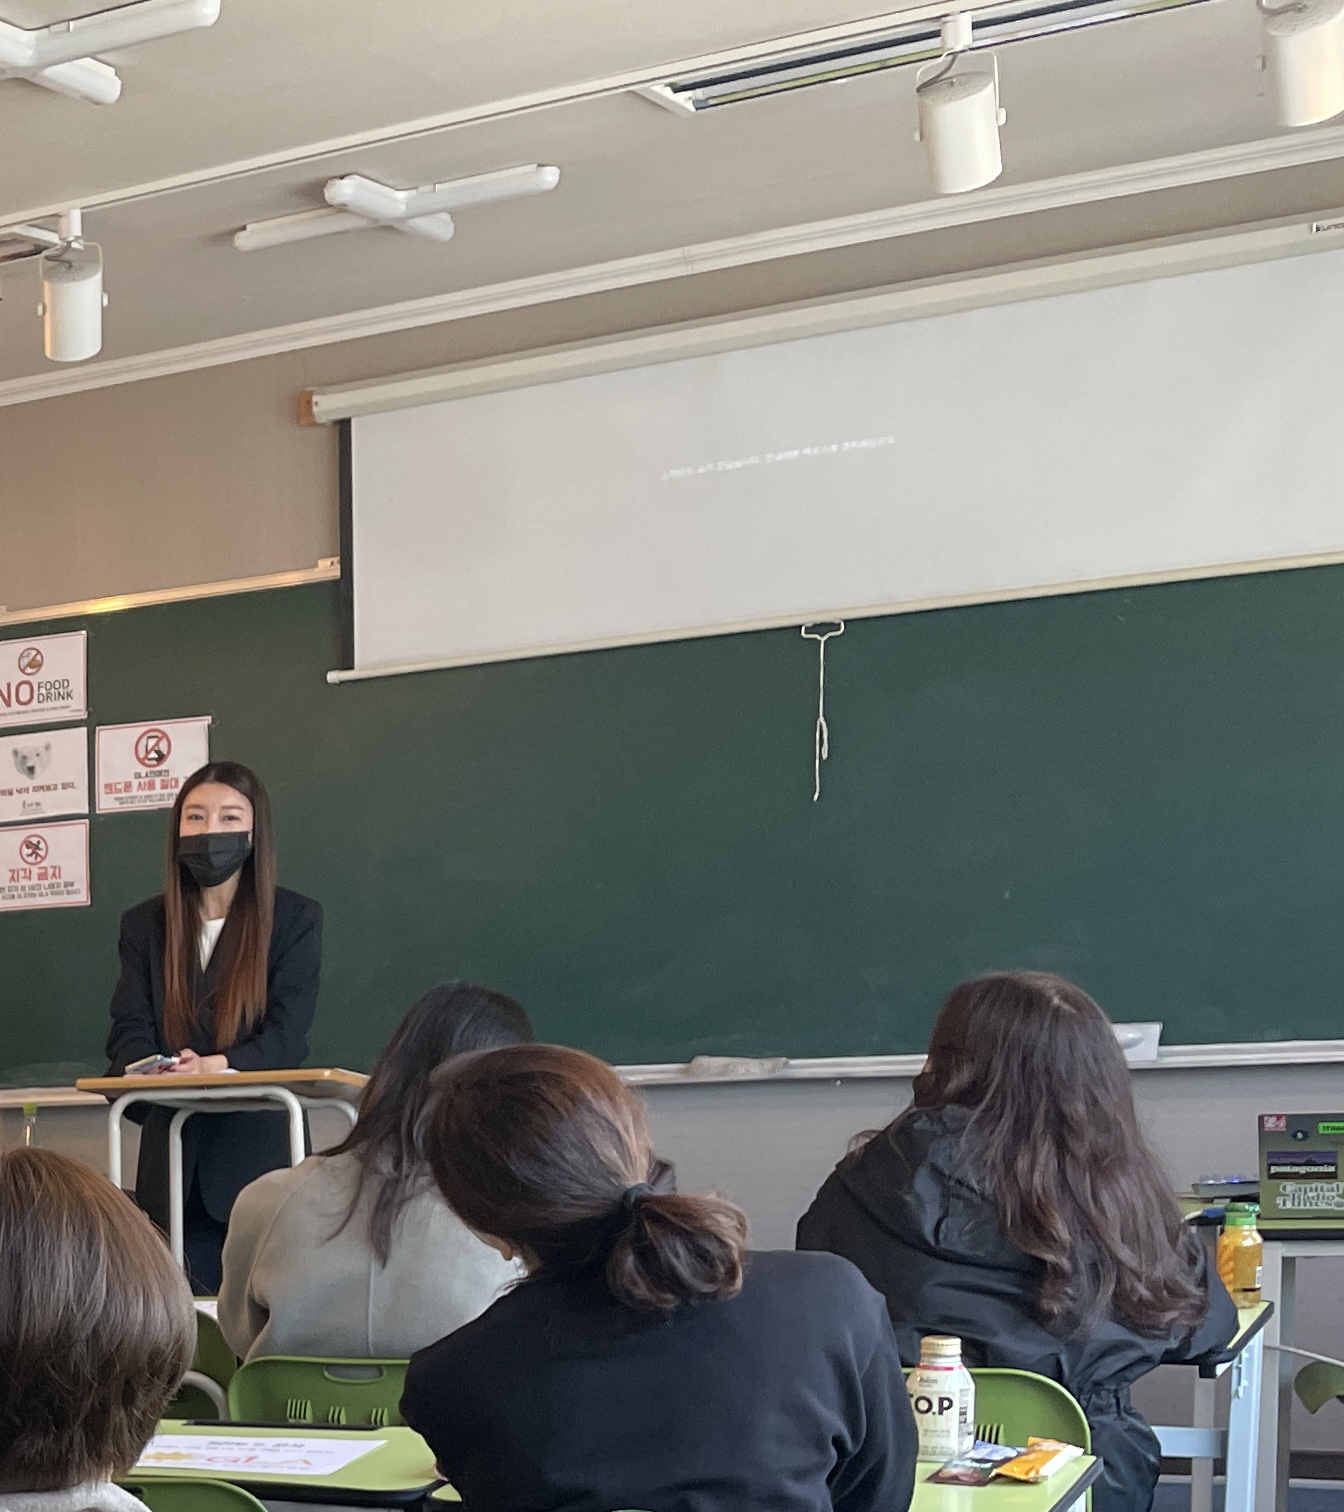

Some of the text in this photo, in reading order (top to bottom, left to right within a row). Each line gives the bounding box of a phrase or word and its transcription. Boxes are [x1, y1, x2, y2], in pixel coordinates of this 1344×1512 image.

[37, 679, 70, 692] FOOD
[37, 690, 74, 704] DRINK
[8, 865, 62, 884] 지각 금지
[1270, 1164, 1336, 1174] patagonia
[1280, 1182, 1343, 1198] Capital
[910, 1394, 954, 1416] O.P
